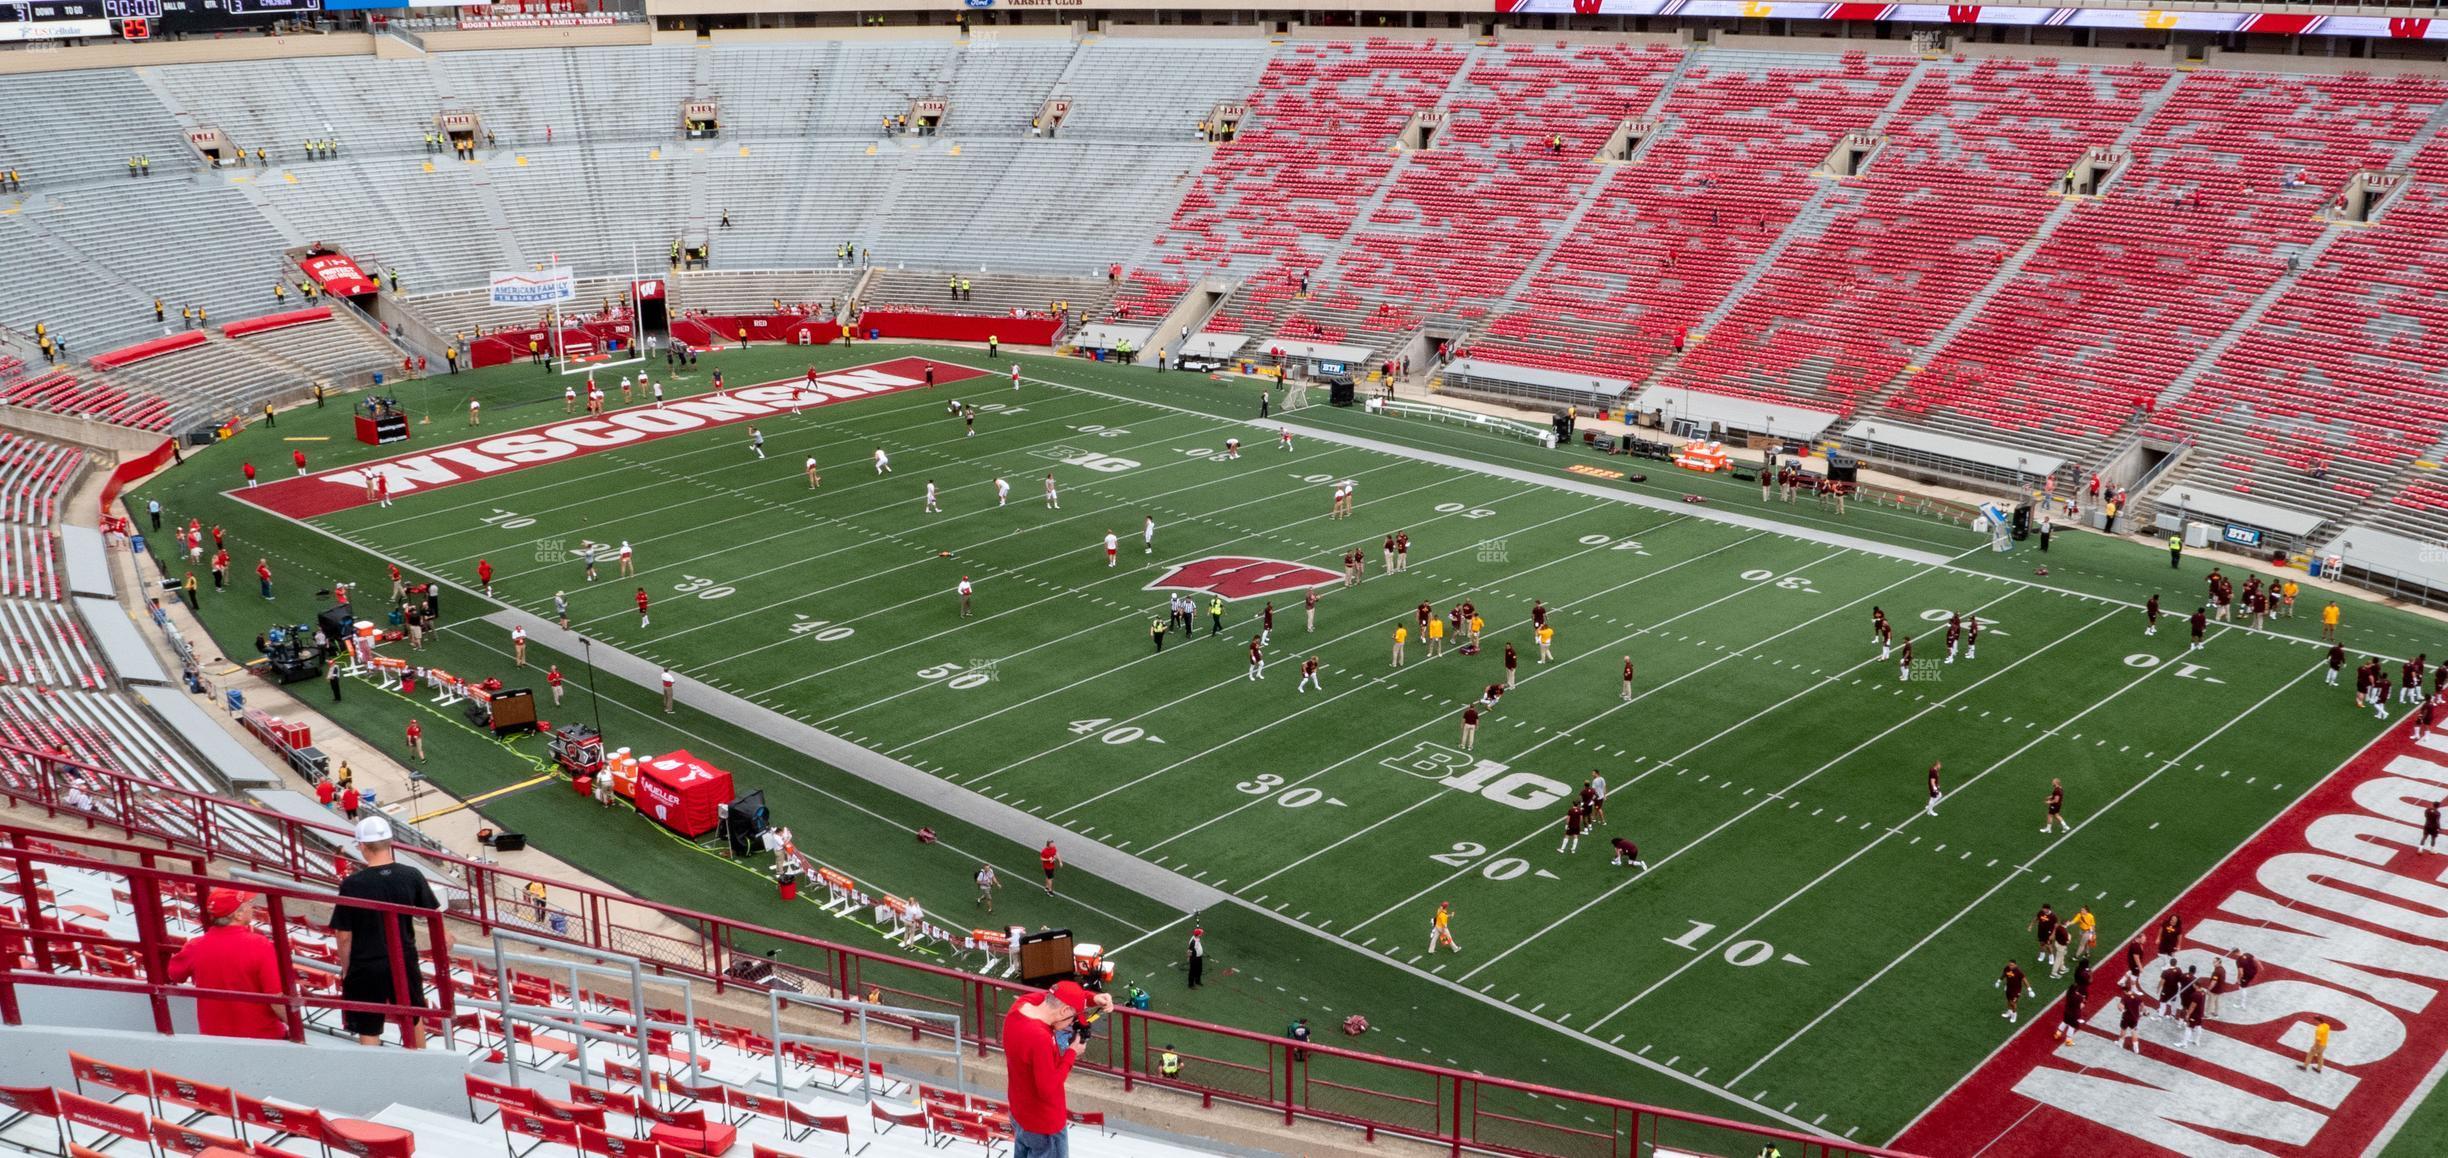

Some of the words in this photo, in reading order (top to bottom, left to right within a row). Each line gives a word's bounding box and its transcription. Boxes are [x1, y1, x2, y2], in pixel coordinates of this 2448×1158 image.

[35, 7, 55, 16] DOWN
[107, 0, 158, 16] 90:00
[124, 19, 147, 37] 25
[550, 18, 577, 26] FAMILY
[579, 17, 613, 25] TERRACE
[494, 286, 536, 296] AMERICAN
[537, 281, 568, 293] FAMILY
[498, 290, 567, 302] INSURANCE
[640, 282, 657, 298] W
[615, 325, 630, 333] RED
[753, 319, 768, 327] RED
[530, 332, 545, 341] RED
[1322, 363, 1341, 373] BTN
[319, 368, 938, 496] WISCONSIN
[2227, 528, 2255, 543] BTN
[1141, 555, 1347, 602] W
[674, 577, 737, 600] 30
[788, 619, 856, 642] 40
[916, 662, 991, 690] 50
[1067, 717, 1145, 745] 40
[644, 780, 680, 805] MUELLER
[1235, 773, 1323, 808] 30
[1429, 841, 1531, 881] 20
[1661, 919, 1775, 967] 10
